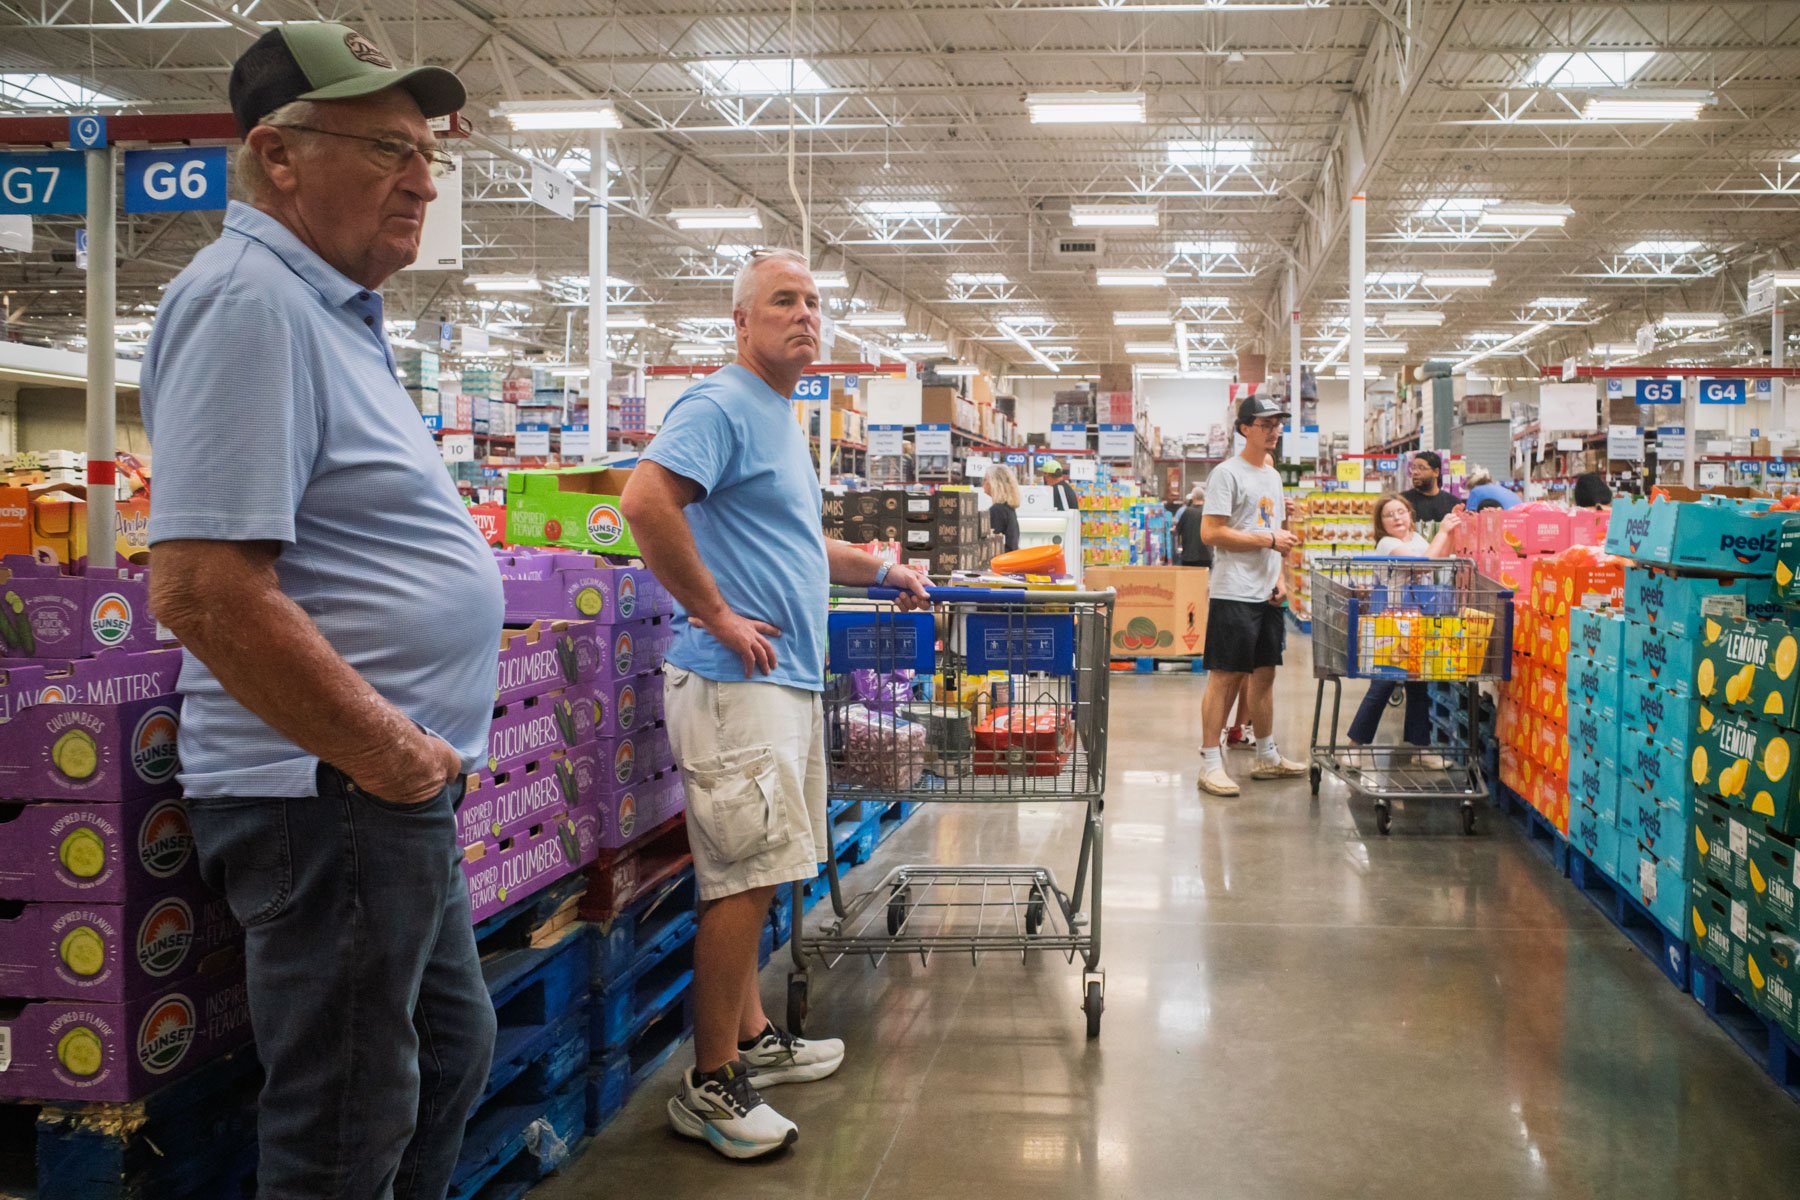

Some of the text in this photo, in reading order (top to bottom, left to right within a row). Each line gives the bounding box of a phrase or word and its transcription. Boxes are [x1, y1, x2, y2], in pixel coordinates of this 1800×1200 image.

[2, 166, 60, 204] G7
[143, 160, 208, 200] G6
[795, 380, 822, 396] G6
[1644, 384, 1673, 400] G5
[1707, 384, 1737, 400] G4
[1006, 454, 1025, 464] C20
[588, 525, 622, 536] SUNSET
[1625, 514, 1650, 538] peelz
[1720, 533, 1777, 552] peelz
[1641, 582, 1664, 607] peelz
[92, 618, 131, 630] SUNSET
[1583, 620, 1601, 643] peelz
[1642, 635, 1667, 664] peelz
[1726, 632, 1768, 666] LEMONS
[496, 648, 559, 690] CUCUMBERS
[1580, 668, 1599, 692] peelz
[87, 672, 161, 705] MATTERS
[1640, 691, 1664, 720] peelz
[46, 711, 106, 734] CUCUMBERS
[493, 714, 558, 761] CUCUMBERS
[134, 743, 178, 768] SUNSE
[1638, 749, 1660, 778] peelz
[463, 774, 560, 828] INSPIRED CUCUMBERS
[50, 812, 80, 837] INSPIRED
[88, 812, 115, 836] FLAVOR
[1639, 804, 1661, 838] peelz
[141, 835, 194, 863] SUNSET
[470, 835, 562, 894] INSPIRED CUCUMBERS
[51, 912, 81, 934] INSPIRED
[89, 912, 116, 936] FLAVOR
[139, 932, 192, 964] SUNSET
[206, 983, 248, 1015] INSPIRE
[47, 1012, 78, 1035] INSPIRED
[86, 1012, 112, 1036] FLAVOR
[140, 1027, 194, 1062] SUNSET
